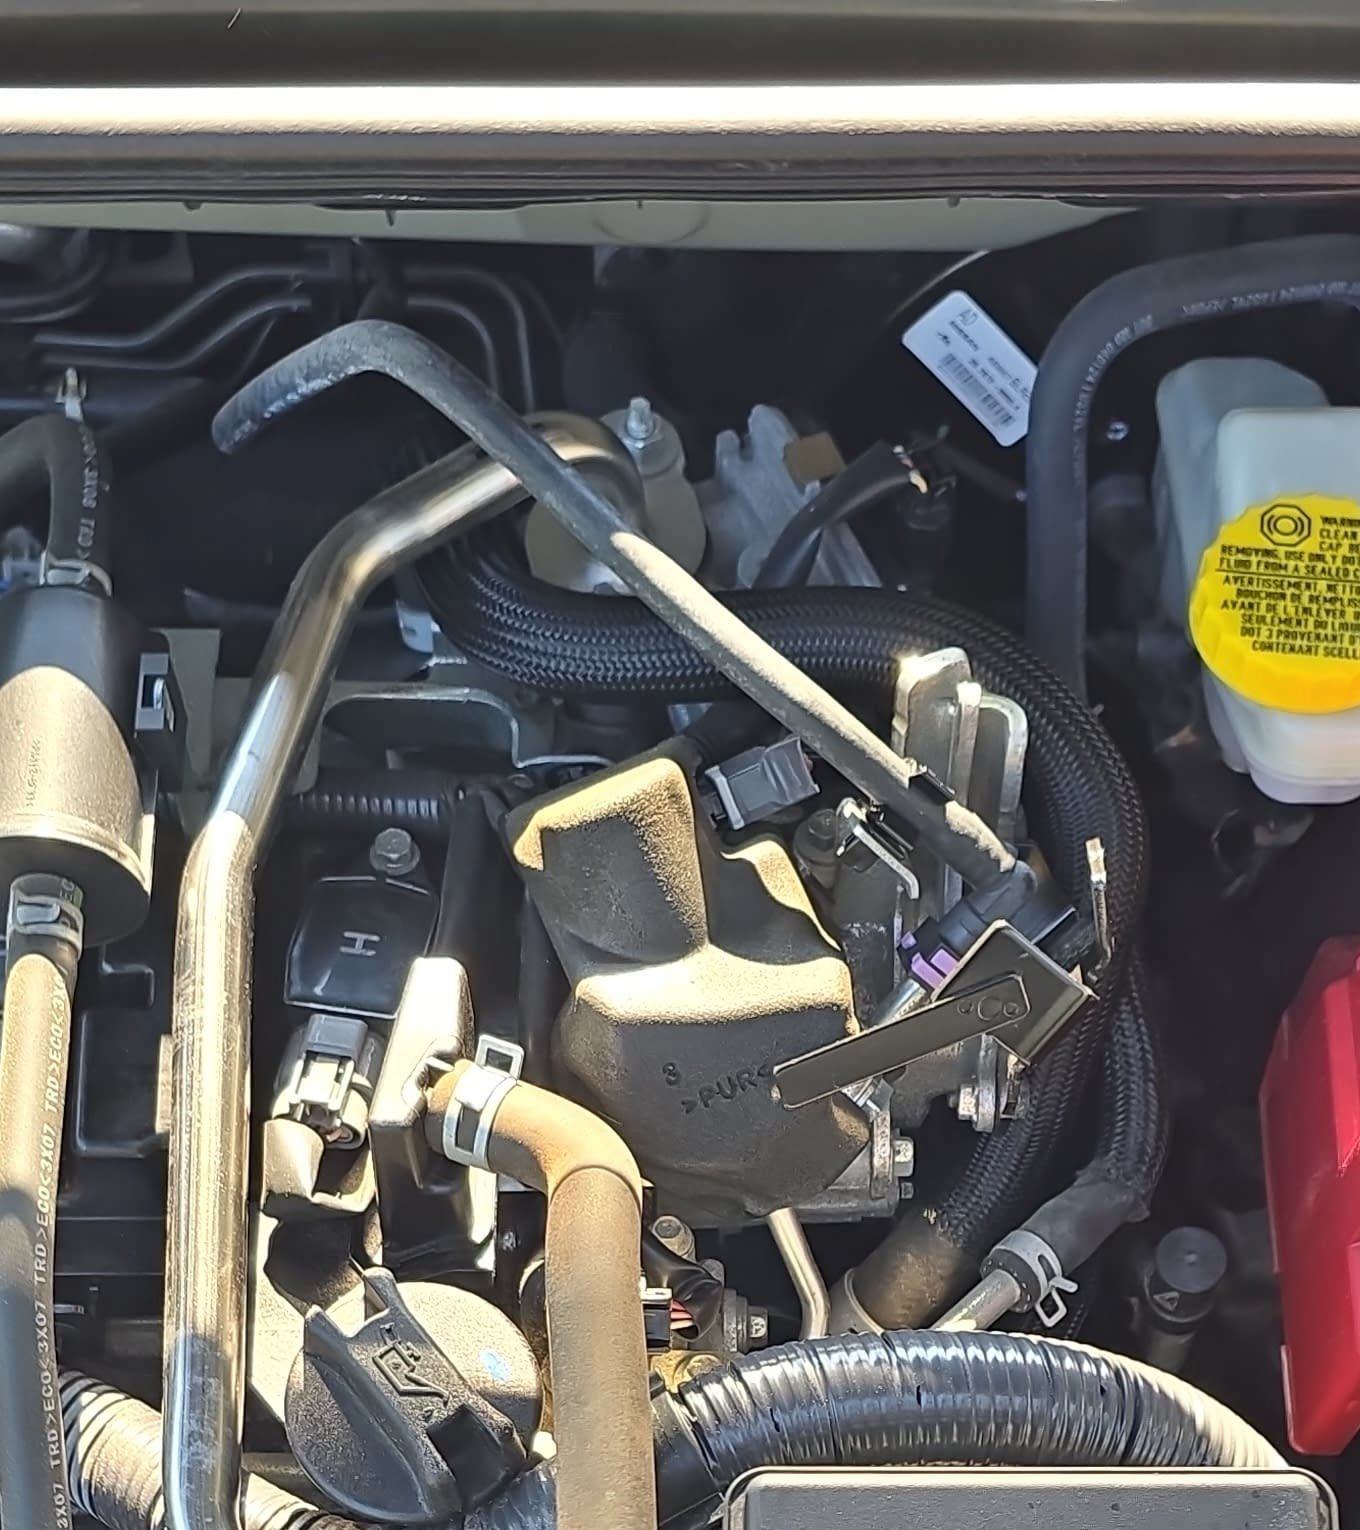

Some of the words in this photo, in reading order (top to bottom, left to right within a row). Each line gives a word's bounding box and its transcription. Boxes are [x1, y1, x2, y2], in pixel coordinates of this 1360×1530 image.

[1320, 529, 1358, 542] CLEAN
[1320, 541, 1343, 553] CAP
[1284, 551, 1305, 561] USE
[1309, 552, 1337, 565] ONLY
[1219, 557, 1252, 570] FLUID
[1256, 560, 1288, 573] FROM
[1293, 564, 1300, 575] A
[1304, 565, 1350, 578] SEALED
[1236, 589, 1286, 602] BOUCHON
[1290, 593, 1303, 604] DE
[1221, 600, 1261, 613] AVANT
[1265, 603, 1278, 614] DE
[1241, 613, 1309, 628] SEULEMENT
[1313, 619, 1328, 630] DU
[1240, 625, 1261, 637] DOT
[1265, 627, 1273, 638] 3
[1276, 628, 1344, 645] PROVENANT
[1252, 639, 1319, 657] CONTENANT
